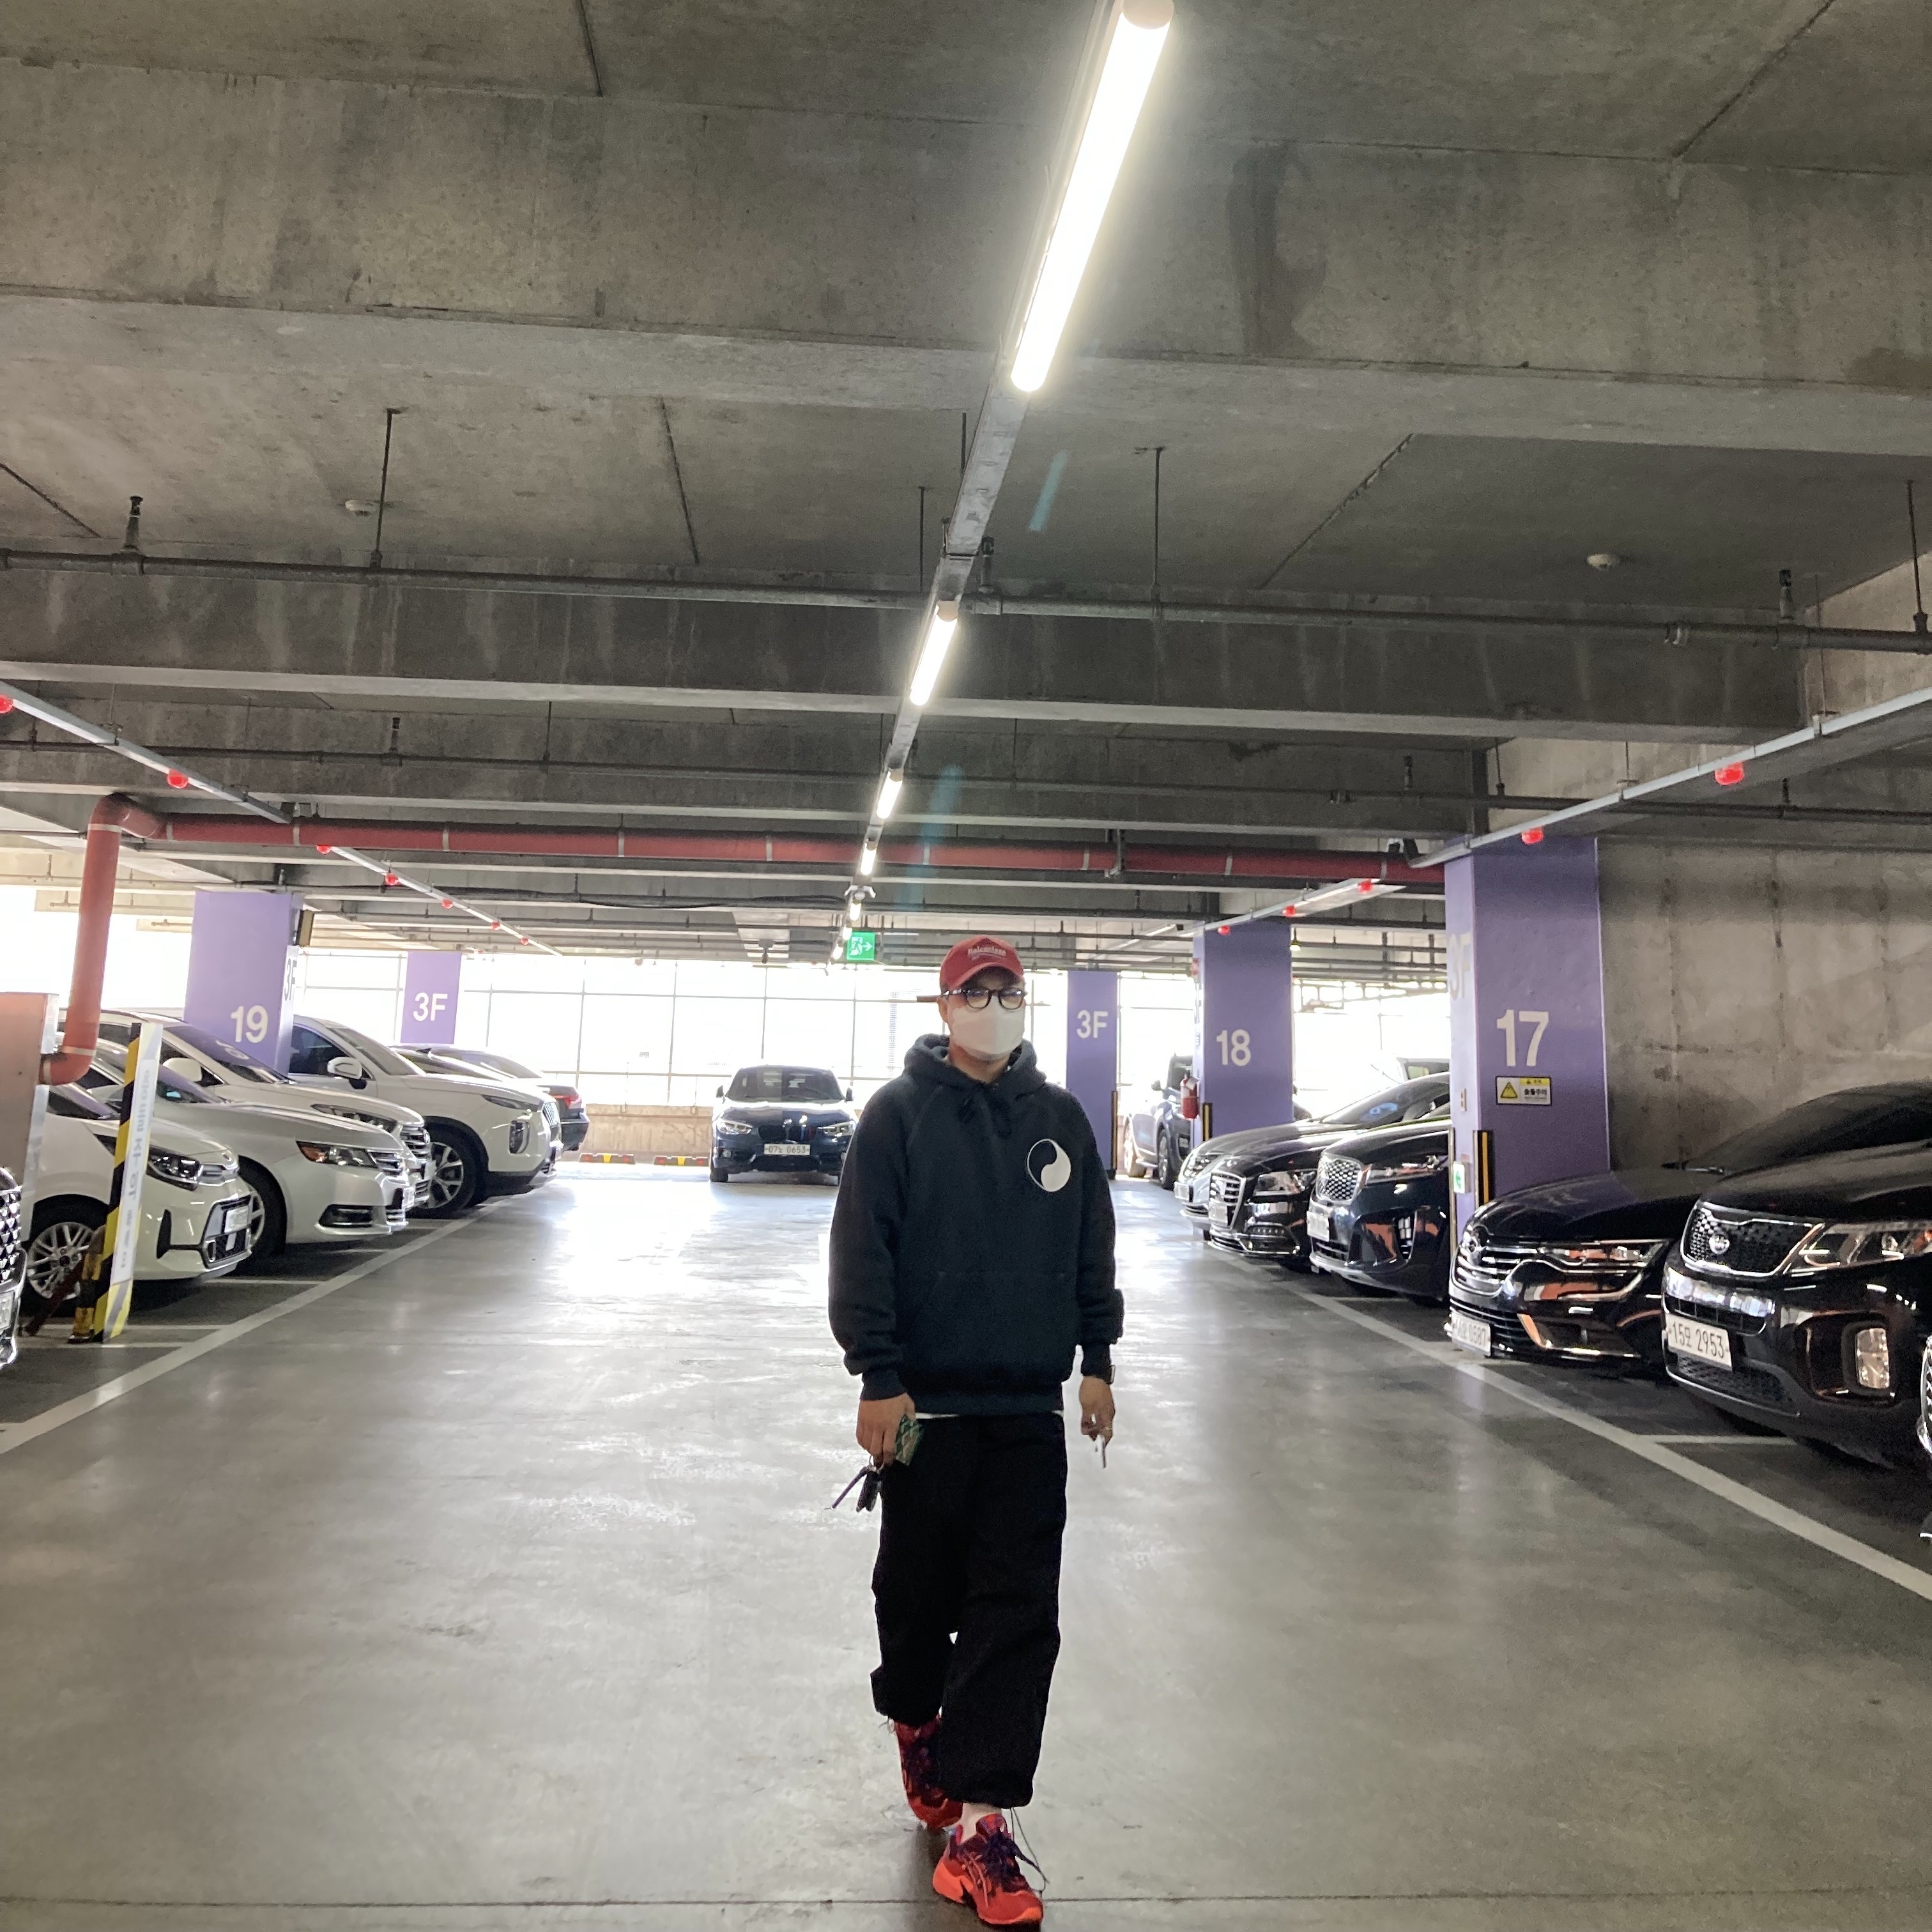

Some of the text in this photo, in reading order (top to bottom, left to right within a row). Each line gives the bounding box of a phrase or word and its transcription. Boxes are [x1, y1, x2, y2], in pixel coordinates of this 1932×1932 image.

[284, 958, 297, 1002] 3F
[231, 1005, 268, 1043] 19
[413, 992, 448, 1022] 3F
[1077, 1009, 1108, 1038] 3F
[1216, 1029, 1252, 1066] 18
[1496, 1009, 1549, 1067] 17
[786, 1146, 806, 1154] 0653
[1673, 1321, 1724, 1359] 15모 2953
